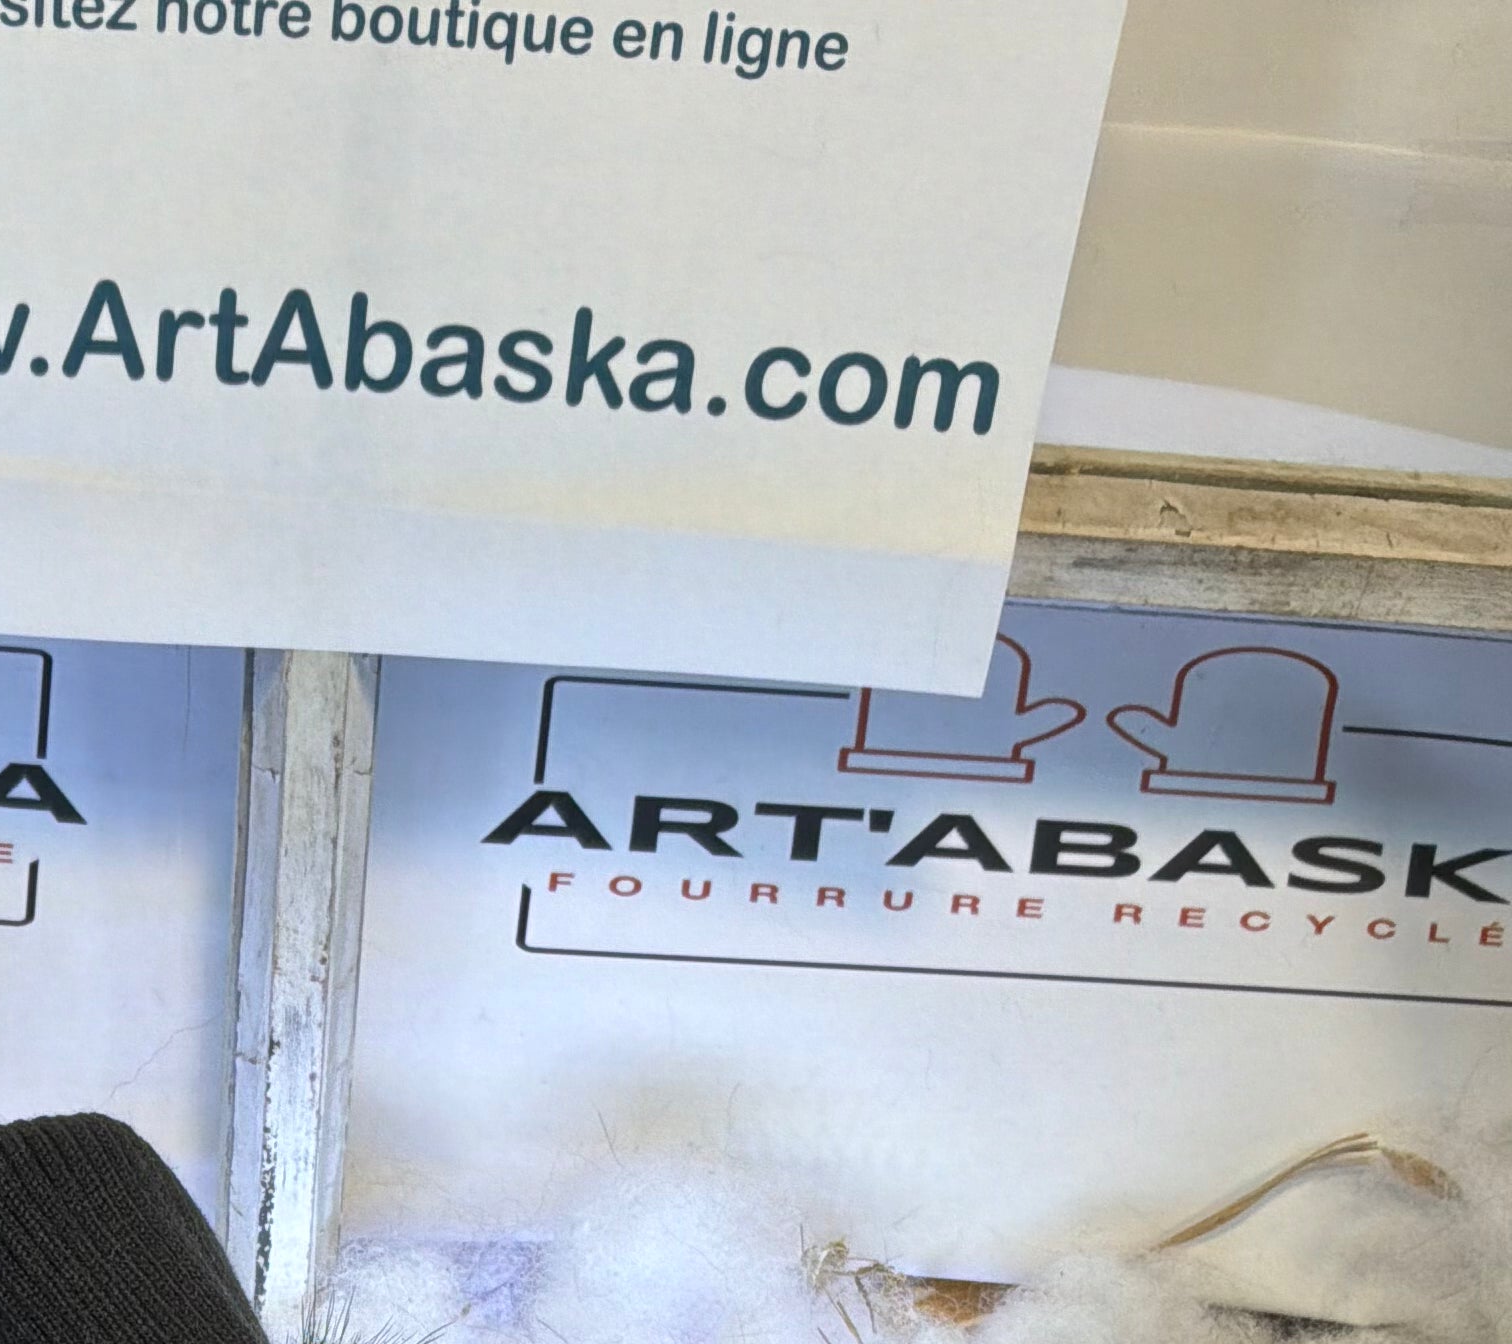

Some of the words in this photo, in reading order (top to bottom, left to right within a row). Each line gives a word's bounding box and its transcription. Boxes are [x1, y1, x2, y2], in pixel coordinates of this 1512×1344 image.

[157, 0, 311, 39] notre
[331, 0, 594, 65] boutique
[613, 19, 684, 61] en
[703, 11, 849, 80] ligne
[547, 872, 1045, 919] FOURRURE
[1113, 903, 1506, 948] RECYCLÉ
